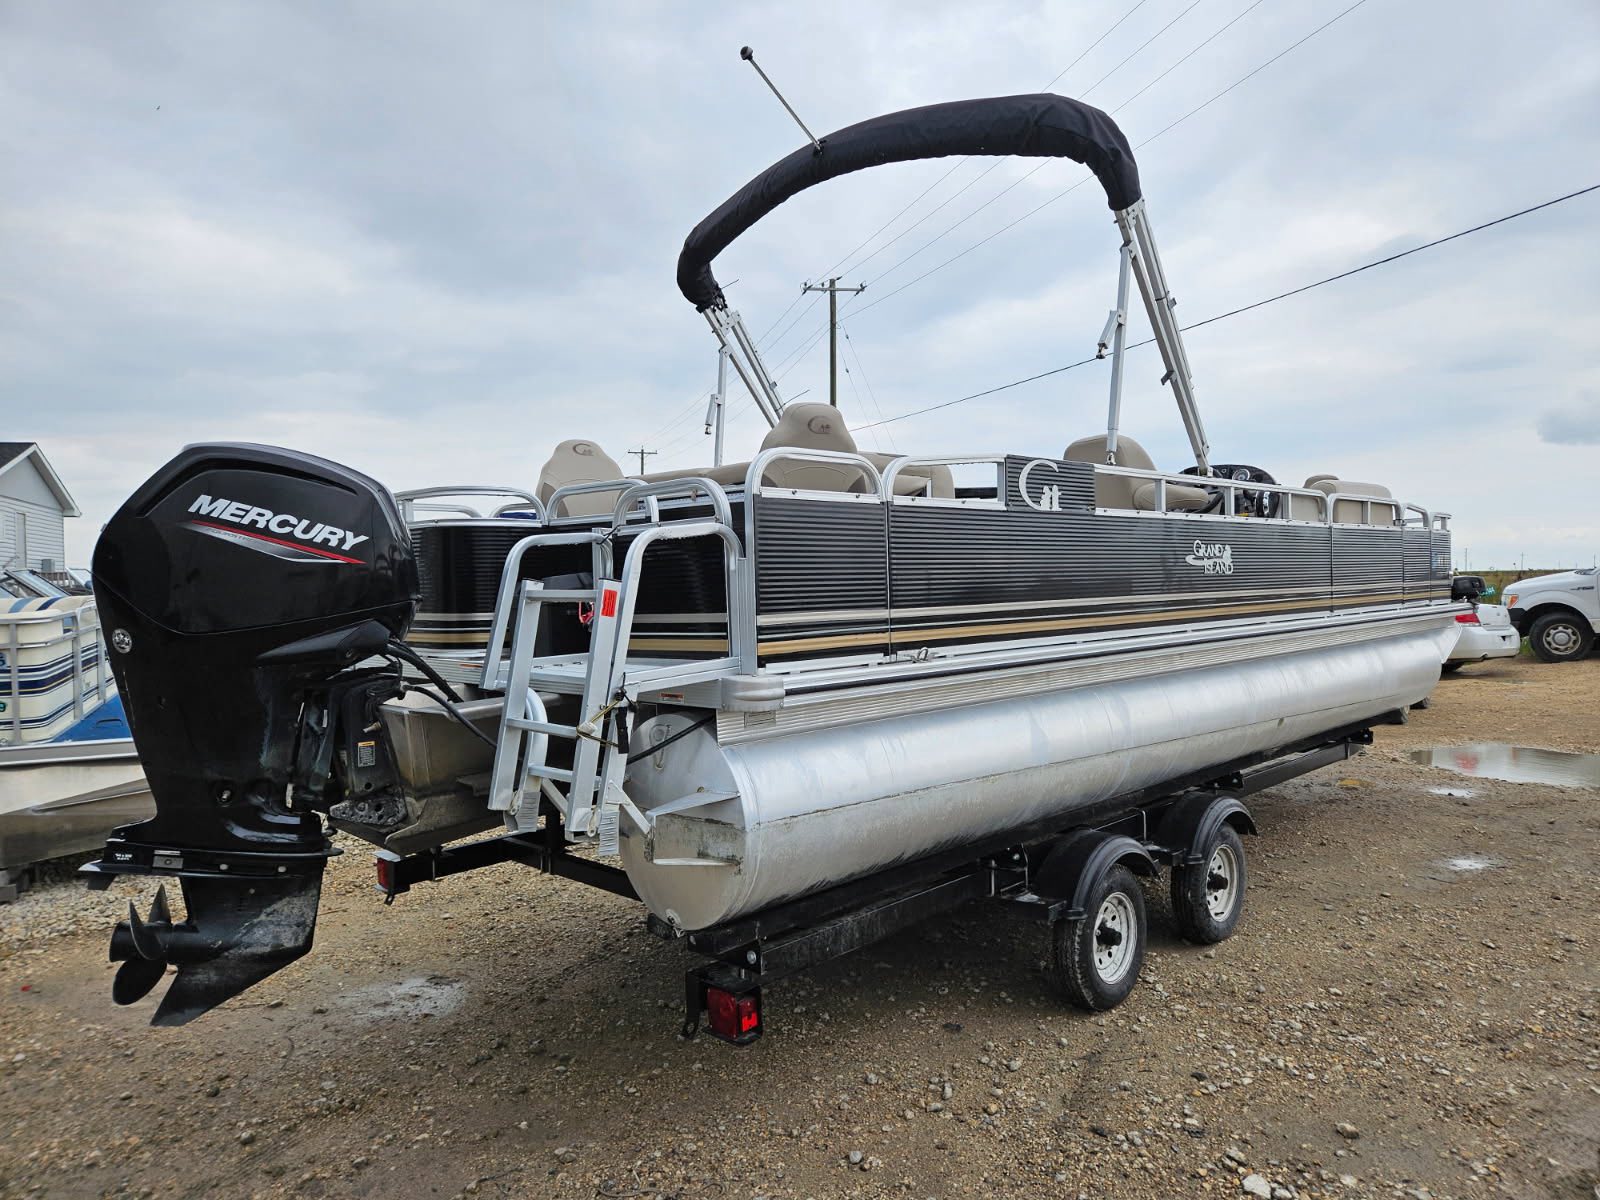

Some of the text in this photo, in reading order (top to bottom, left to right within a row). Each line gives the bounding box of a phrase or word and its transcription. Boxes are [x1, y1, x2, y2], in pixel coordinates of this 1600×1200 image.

[187, 494, 369, 551] MERCURY
[1193, 539, 1224, 557] GRAND
[1203, 559, 1234, 575] ISLAND
